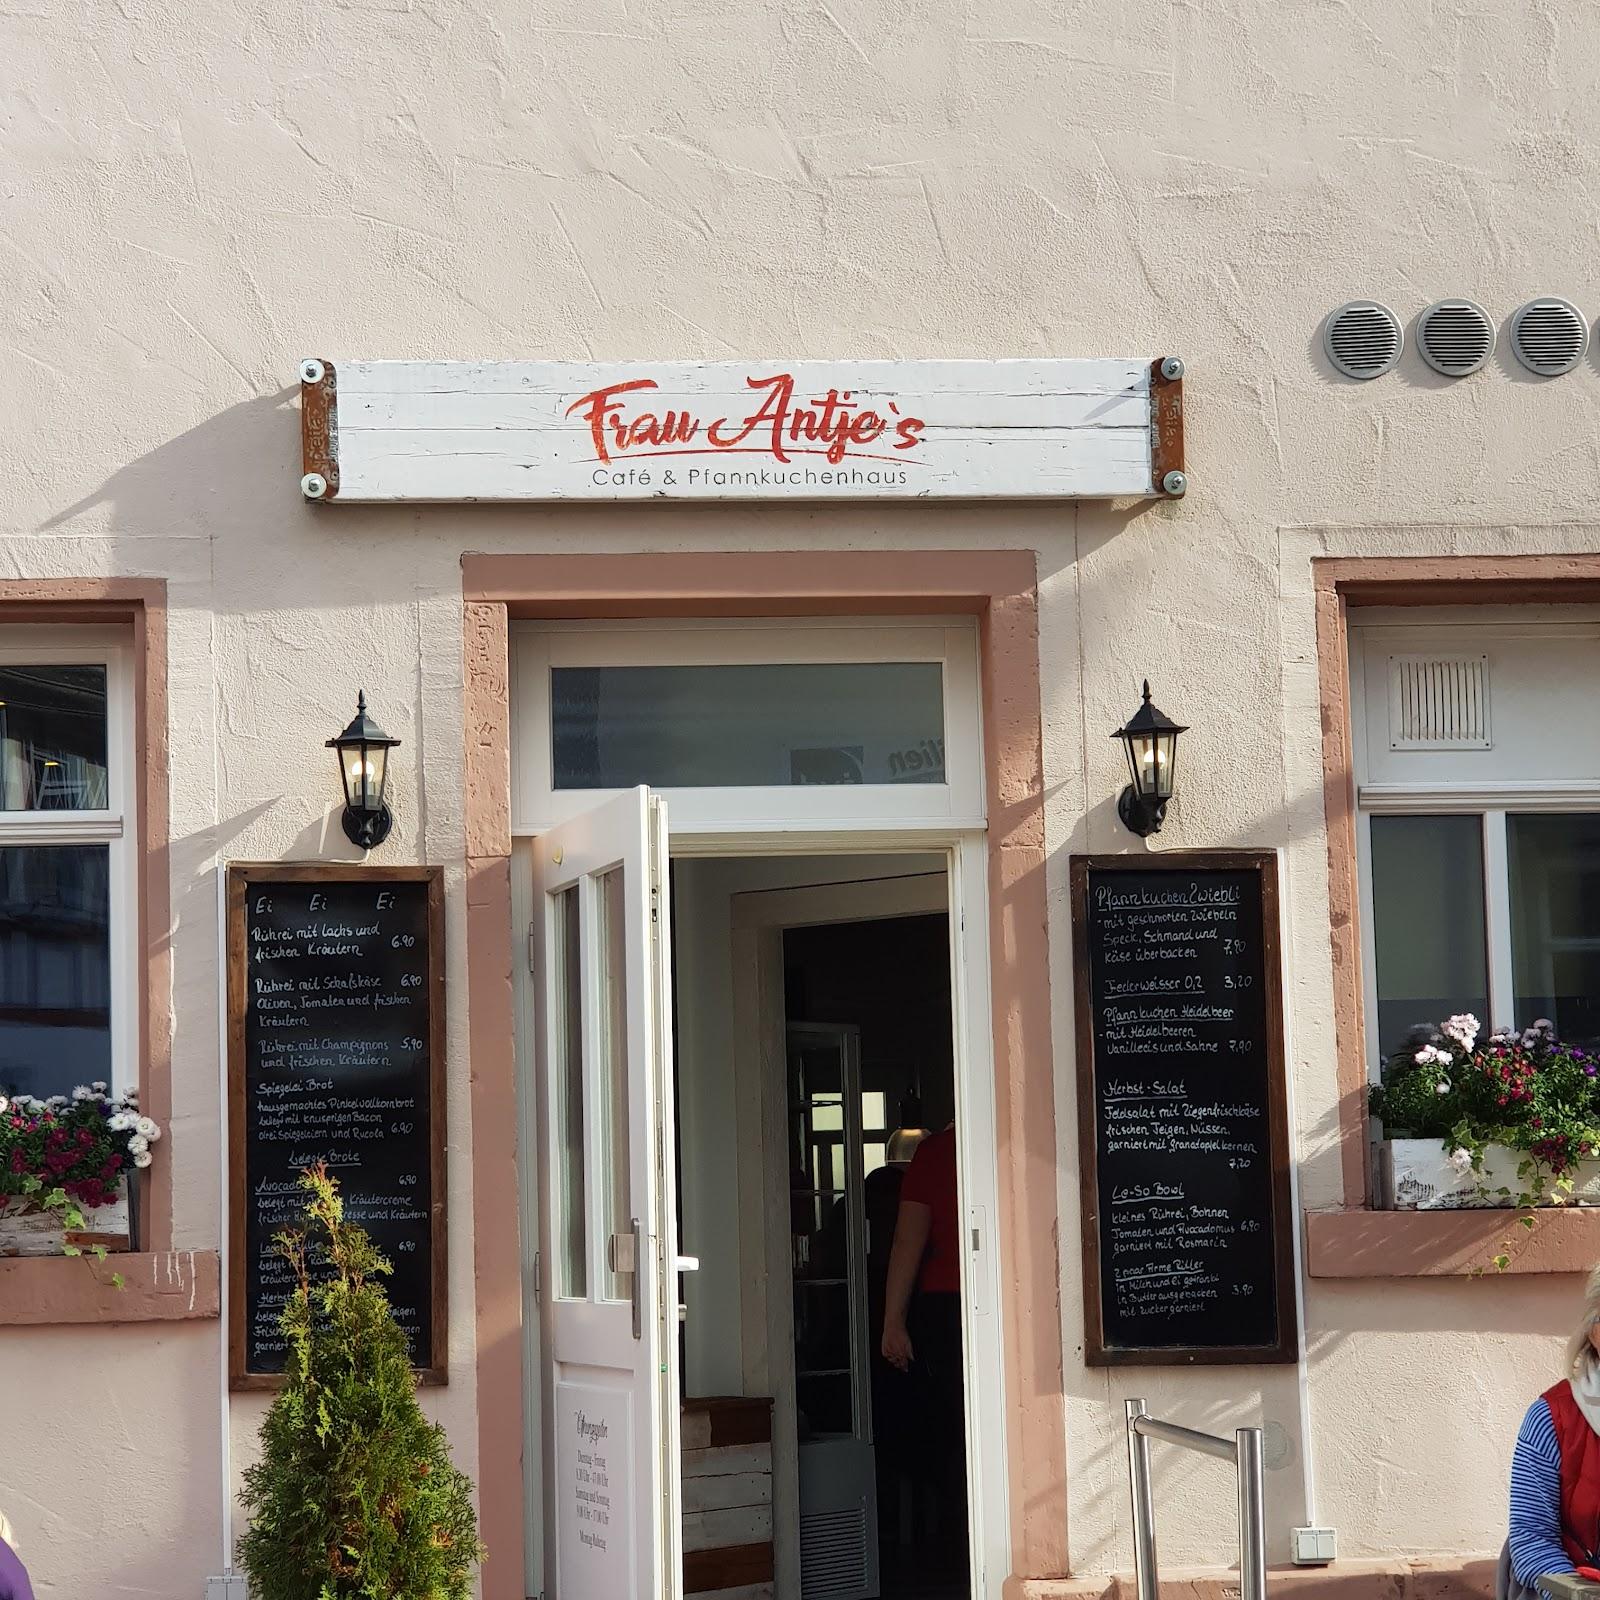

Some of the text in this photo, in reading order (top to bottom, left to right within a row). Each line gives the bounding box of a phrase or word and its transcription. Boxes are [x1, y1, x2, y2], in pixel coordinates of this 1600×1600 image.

[565, 379, 699, 466] Frau
[592, 467, 907, 486] Café & Pfannkuchenhaus
[255, 892, 396, 914] Ei Ei Ei
[1127, 913, 1188, 931] geschmorten
[1191, 910, 1237, 923] Zwiebeln
[251, 926, 293, 943] Rührei
[297, 923, 318, 938] mit
[355, 921, 380, 936] und
[1143, 929, 1193, 943] Schmand
[1195, 928, 1218, 939] und
[254, 942, 364, 963] frischen Kräutern
[1135, 947, 1198, 962] überbacken
[255, 977, 295, 994] Rührei
[298, 976, 320, 991] mit
[322, 972, 382, 990] Schafskäse
[1224, 976, 1252, 990] 3,20
[346, 994, 371, 1006] und
[374, 992, 412, 1011] frischen
[259, 1014, 310, 1027] Kräutern
[1103, 1004, 1234, 1026] Pfannkuchen Heidelbeer
[1128, 1023, 1197, 1039] Heidelbeeren
[258, 1039, 298, 1053] Rührei
[299, 1038, 319, 1051] mit
[321, 1038, 389, 1056] Champignons
[1159, 1042, 1183, 1053] und
[1185, 1040, 1219, 1053] Sahne
[260, 1053, 392, 1070] und frischen Kräutern
[256, 1077, 335, 1099] Spiegelei Brot
[285, 1115, 301, 1124] mit
[352, 1111, 383, 1123] Bacon
[1159, 1103, 1180, 1118] mit
[1181, 1102, 1260, 1119] Ziegenfrischkäse
[258, 1132, 277, 1141] drei
[331, 1127, 350, 1139] und
[352, 1127, 385, 1140] Rucola
[1105, 1124, 1150, 1138] frischen
[1107, 1140, 1149, 1154] garniert
[1149, 1138, 1167, 1149] mit
[328, 1148, 361, 1163] Brote
[1153, 1181, 1185, 1196] Bowl
[286, 1194, 305, 1208] mit
[350, 1193, 413, 1207] Kräutercreme
[368, 1209, 389, 1220] und
[390, 1209, 428, 1220] Kräutern
[1189, 1205, 1229, 1219] Bohnen
[1155, 1224, 1176, 1236] und
[1154, 1239, 1174, 1250] mit
[1175, 1235, 1228, 1249] Rosmarin
[1172, 1258, 1204, 1271] Ritter
[1152, 1277, 1170, 1288] und
[1119, 1307, 1137, 1318] mit
